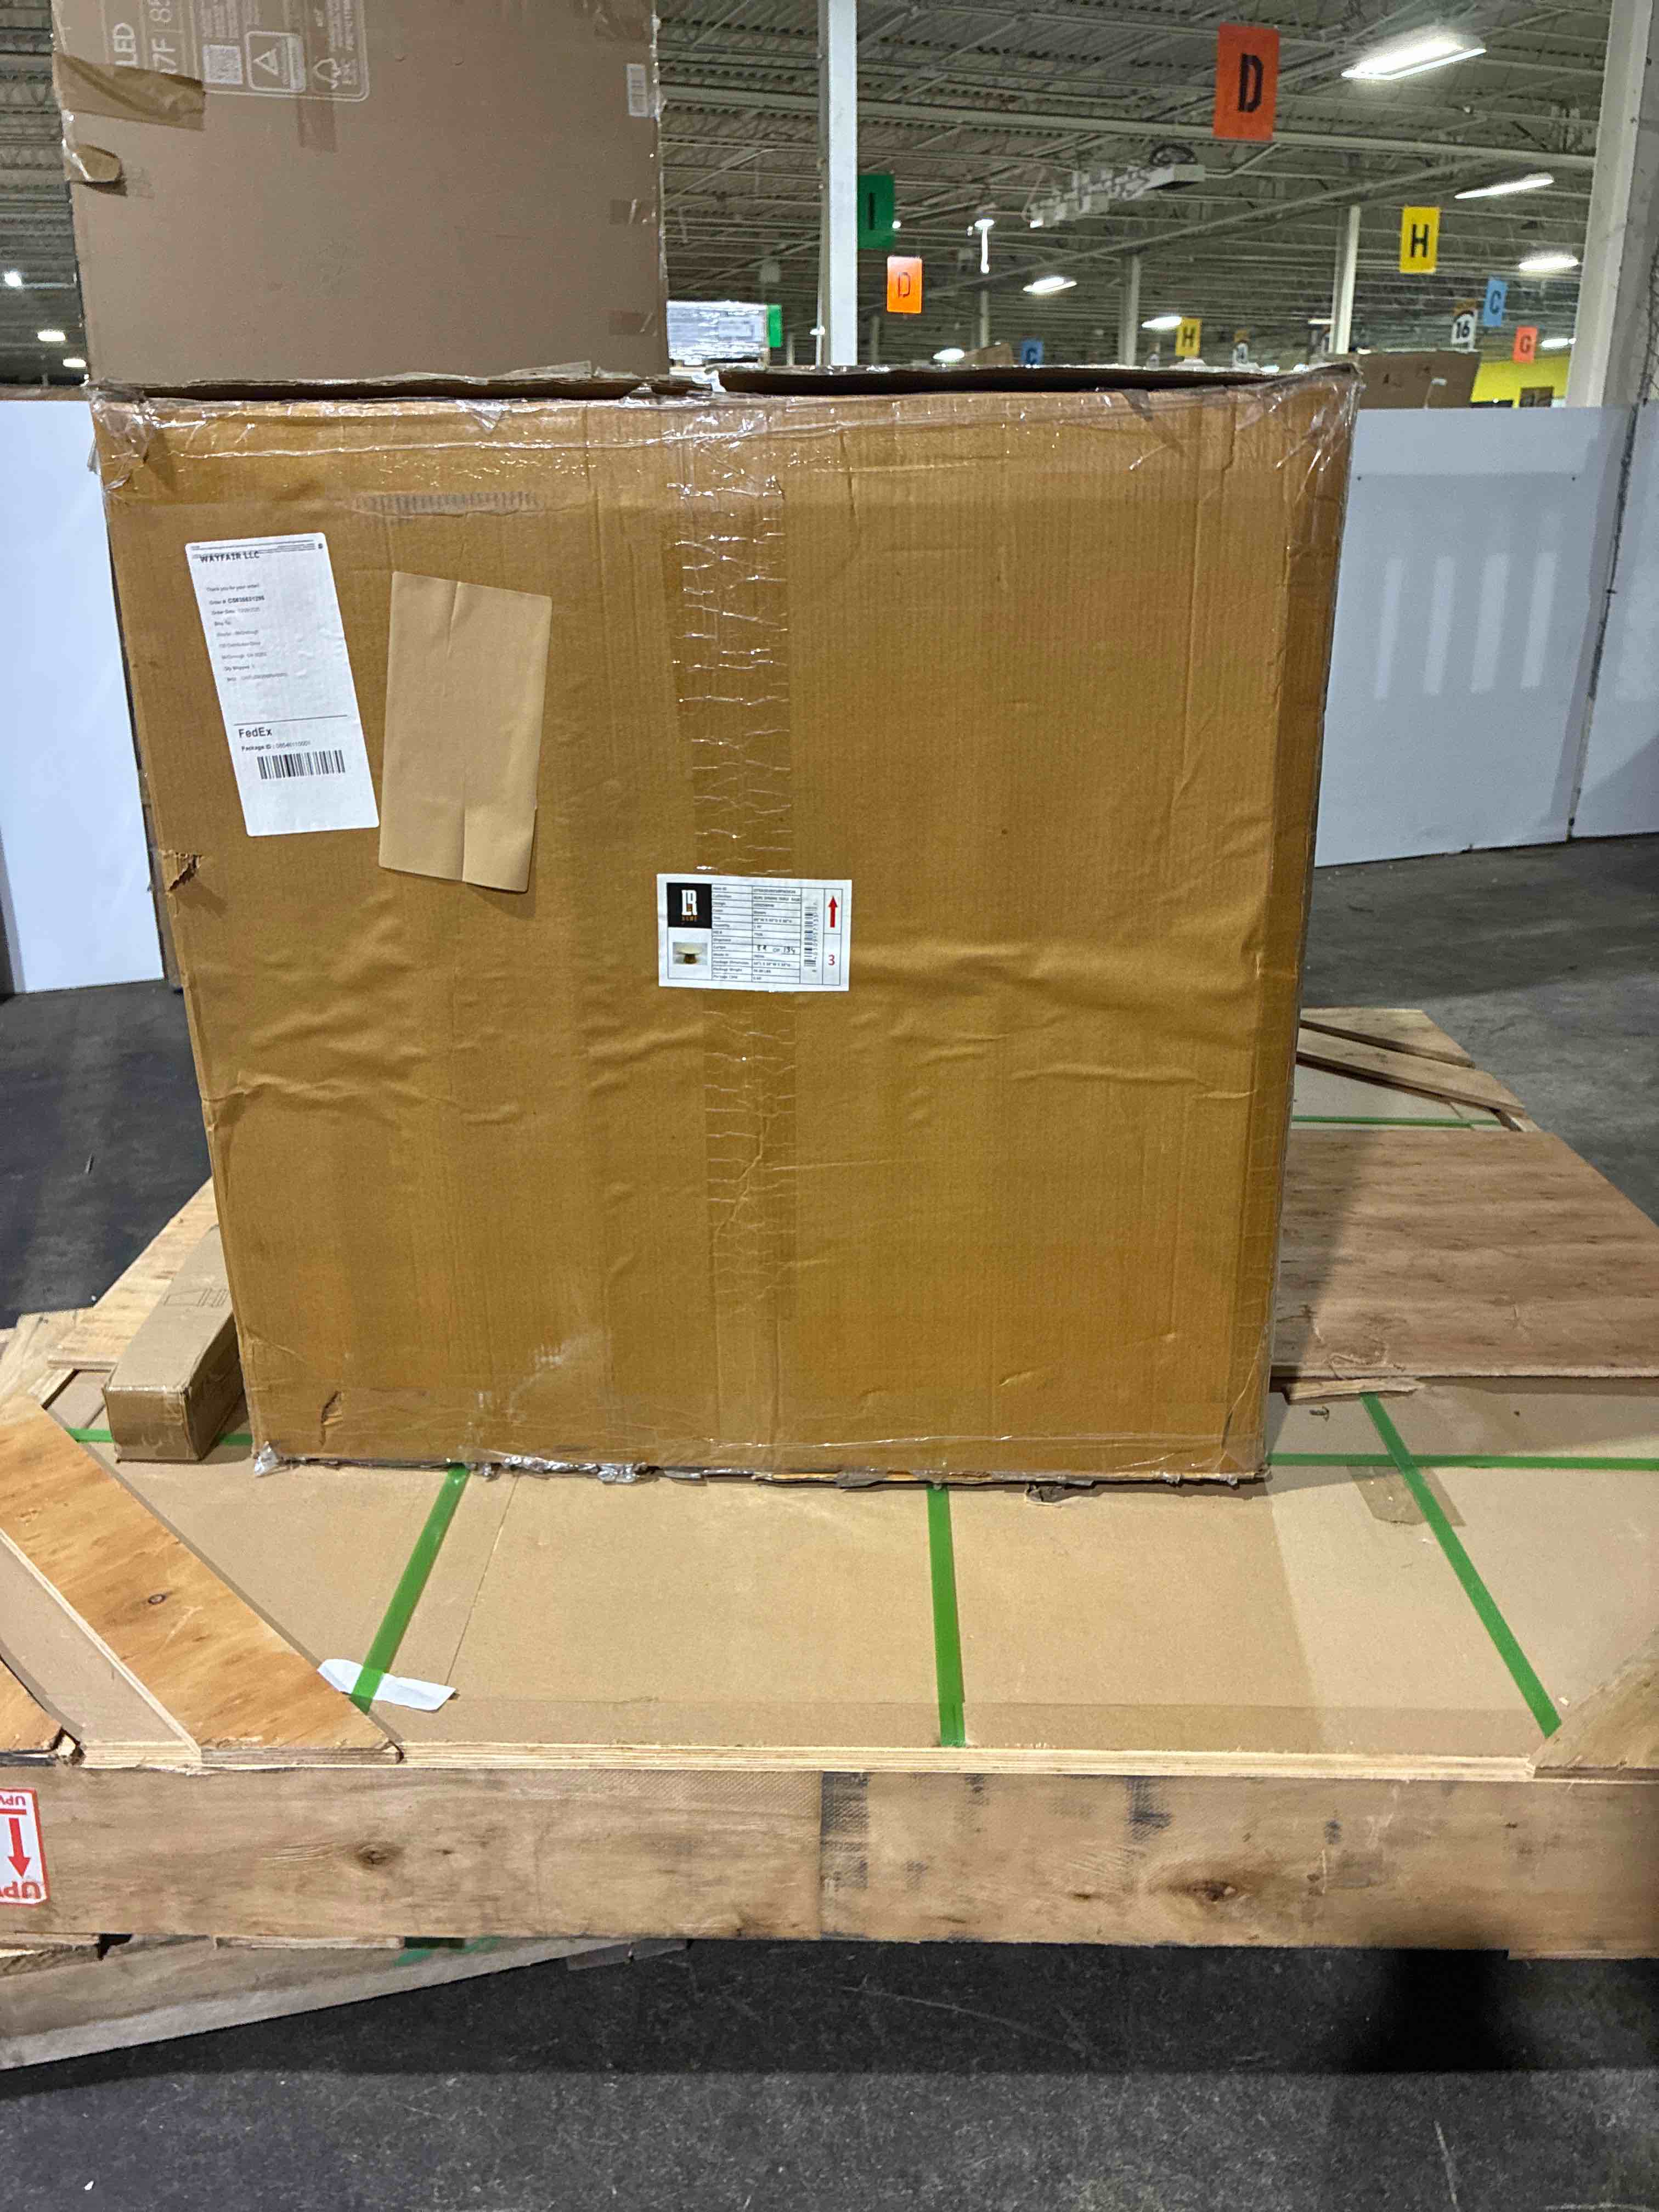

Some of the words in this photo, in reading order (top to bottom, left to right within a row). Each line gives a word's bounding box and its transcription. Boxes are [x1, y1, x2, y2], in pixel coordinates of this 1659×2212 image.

[151, 38, 177, 74] 7F
[1238, 53, 1263, 112] D
[1410, 224, 1428, 258] H
[898, 272, 911, 297] D
[1489, 290, 1502, 314] C
[1182, 326, 1196, 347] H
[1455, 321, 1470, 339] 16
[1520, 335, 1531, 354] G
[200, 553, 241, 563] WAYFAIR
[244, 551, 260, 560] LLC
[238, 727, 273, 738] FedEx
[828, 954, 836, 966] 3
[0, 1881, 41, 1899] UP
